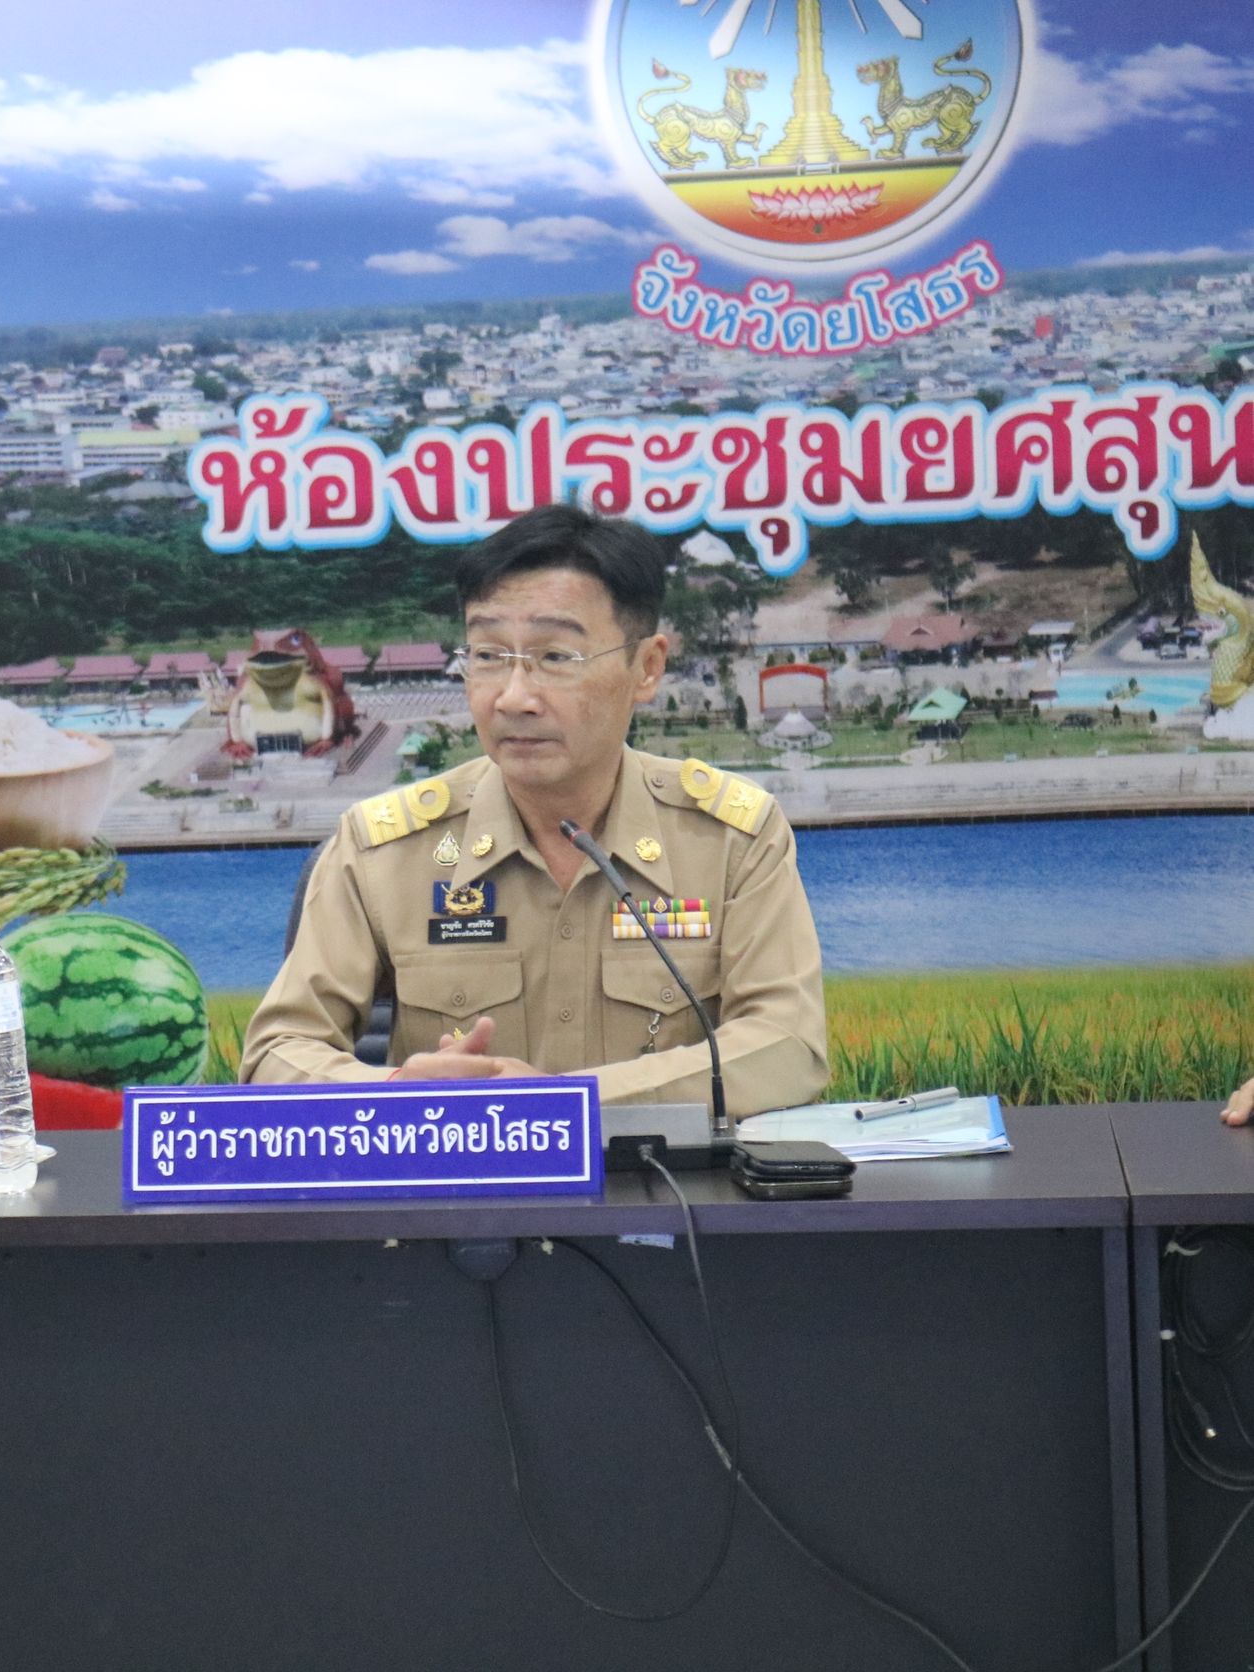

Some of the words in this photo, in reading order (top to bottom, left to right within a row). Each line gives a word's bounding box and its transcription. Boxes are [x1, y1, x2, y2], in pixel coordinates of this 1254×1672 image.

[635, 243, 1003, 353] จังหวัดยโสธร
[151, 1106, 571, 1177] ผู้ว่าราชการจังหวัดยโสธร
